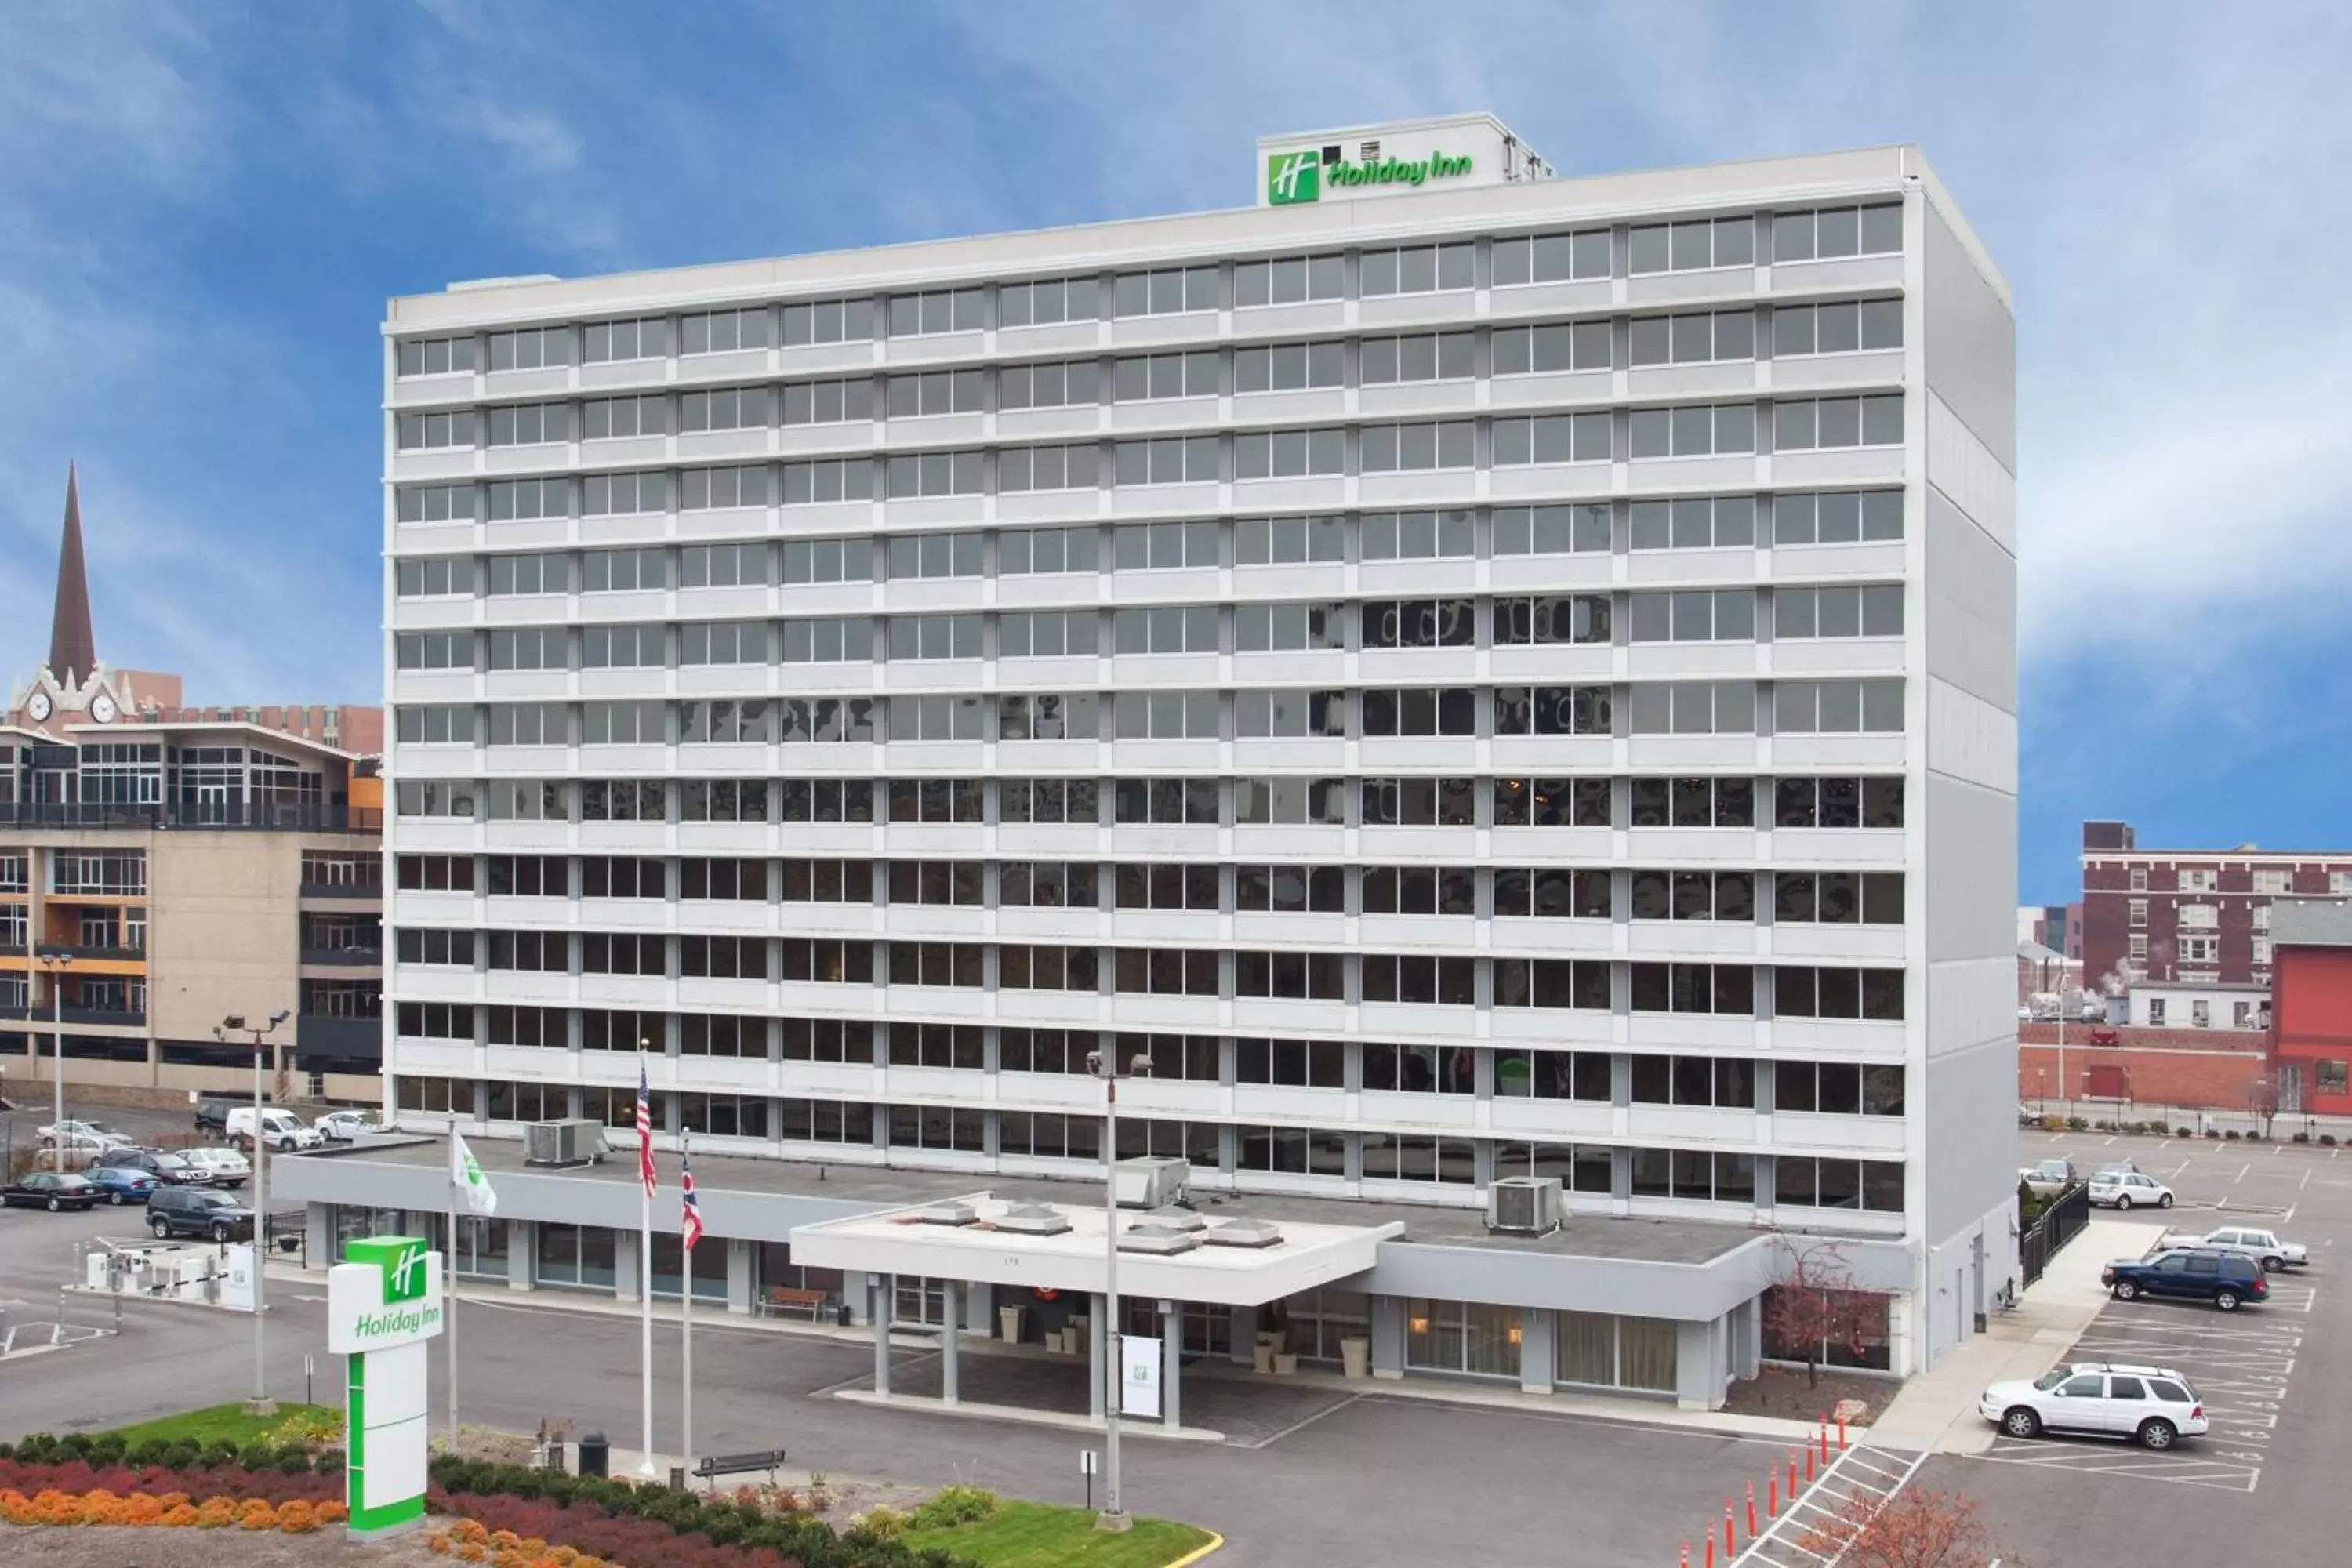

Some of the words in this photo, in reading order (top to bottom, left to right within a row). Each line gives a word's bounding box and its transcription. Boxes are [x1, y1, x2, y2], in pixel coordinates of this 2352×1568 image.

[1327, 155, 1428, 187] Holiday
[1430, 150, 1472, 179] Inn
[355, 1310, 420, 1338] Holiday
[422, 1303, 439, 1324] Inn
